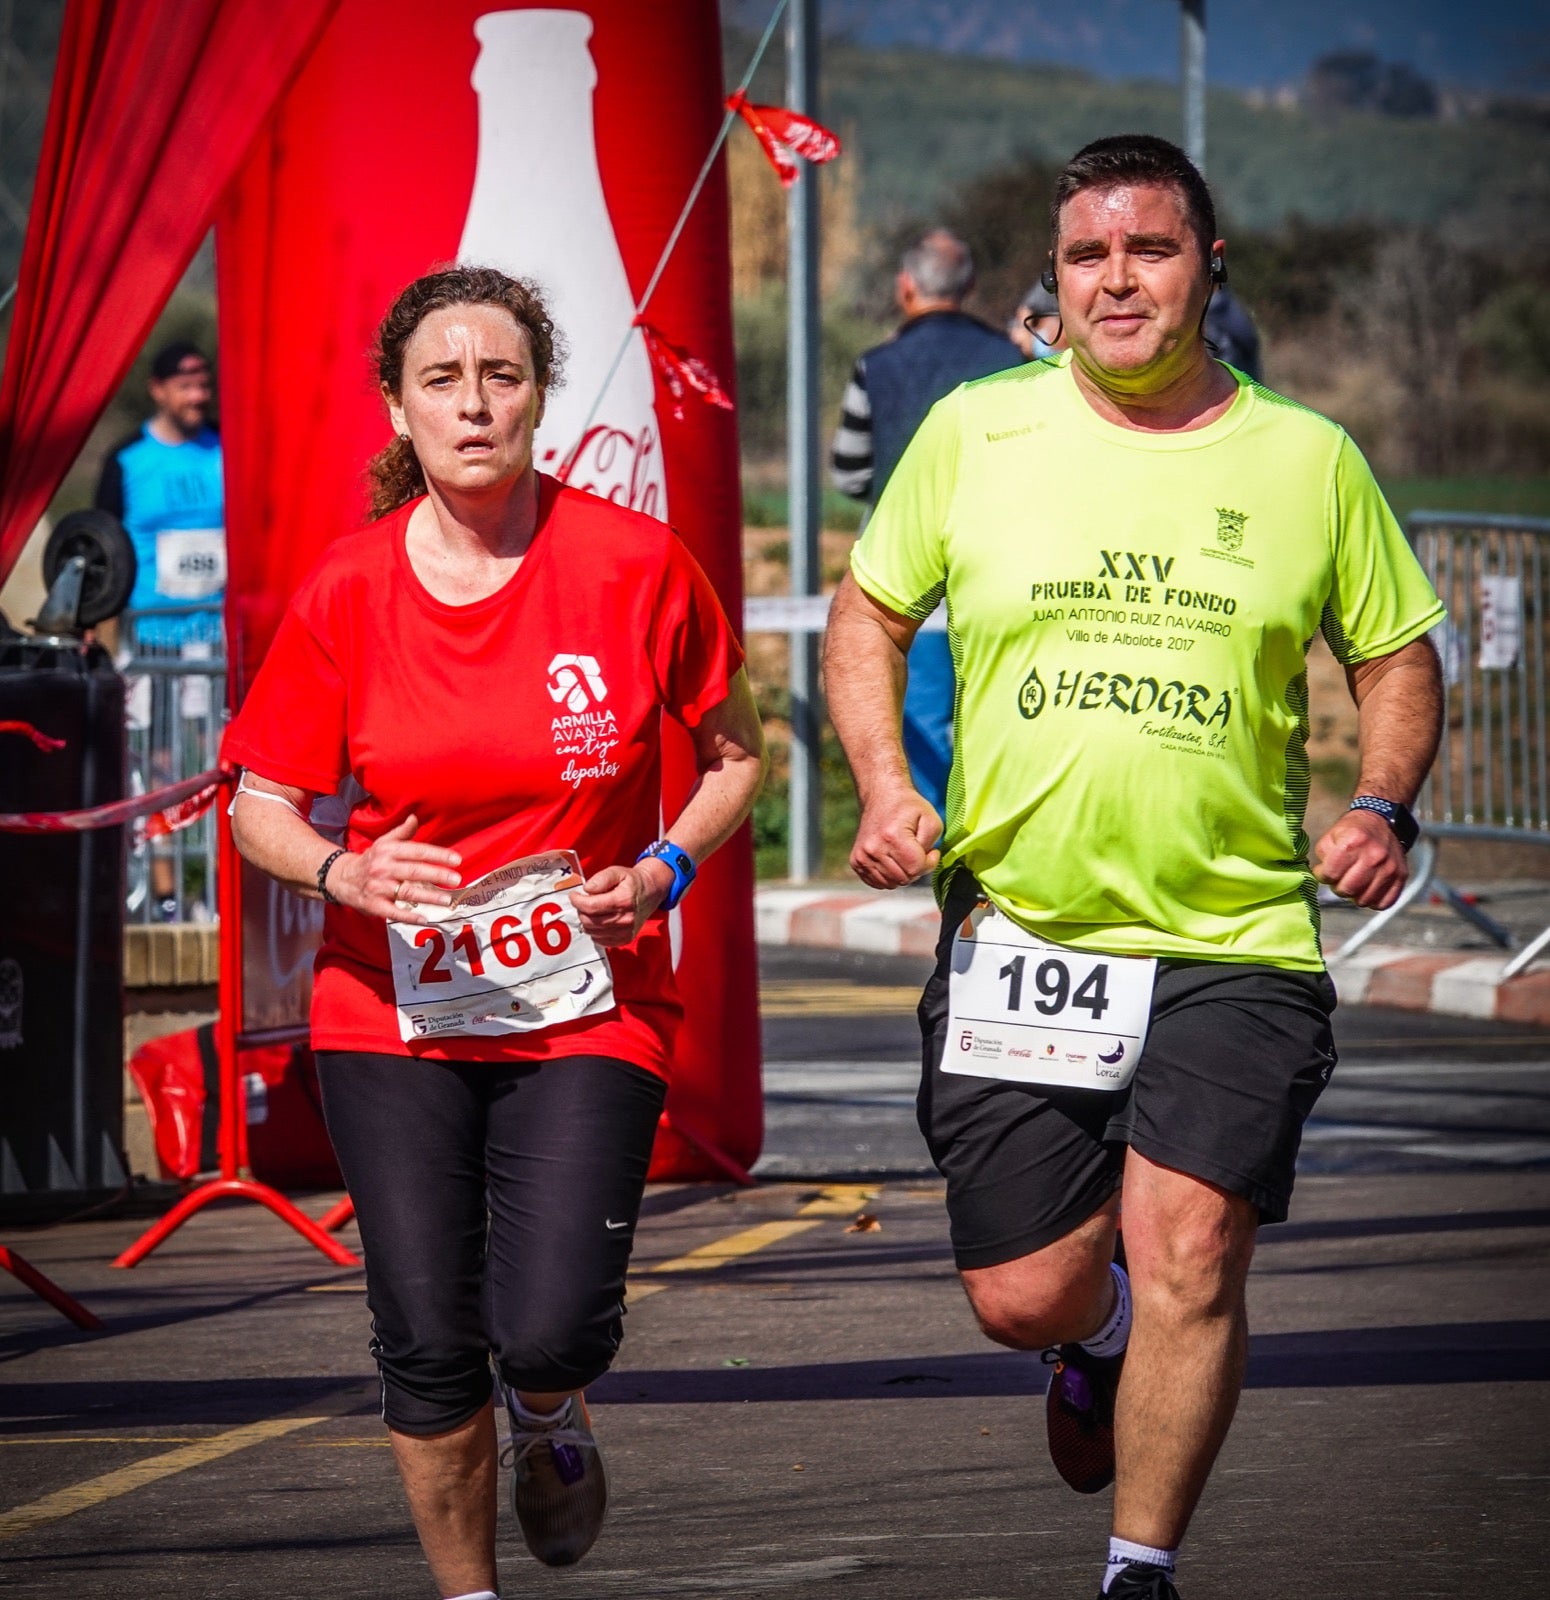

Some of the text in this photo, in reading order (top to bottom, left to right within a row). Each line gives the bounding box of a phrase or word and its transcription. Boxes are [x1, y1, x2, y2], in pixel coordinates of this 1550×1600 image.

[1098, 550, 1175, 583] XXV
[1031, 581, 1237, 616] PRUEBA DE FONDO
[1032, 608, 1232, 638] JUAN ANTONIO RUIZ NAVARRO
[1066, 629, 1196, 652] Villa de Albolote 2017
[1053, 669, 1233, 730] HEROGRA
[551, 709, 616, 731] ARMILLA
[553, 722, 619, 743] AVANZA
[556, 733, 620, 759] contigo
[1139, 721, 1227, 750] Fertilizantes, S.A.
[560, 758, 621, 790] deportes
[494, 865, 524, 883] FONDO
[414, 901, 573, 985] 2166
[999, 954, 1110, 1020] 194
[427, 1011, 464, 1024] Diputación
[429, 1018, 466, 1031] de Granada
